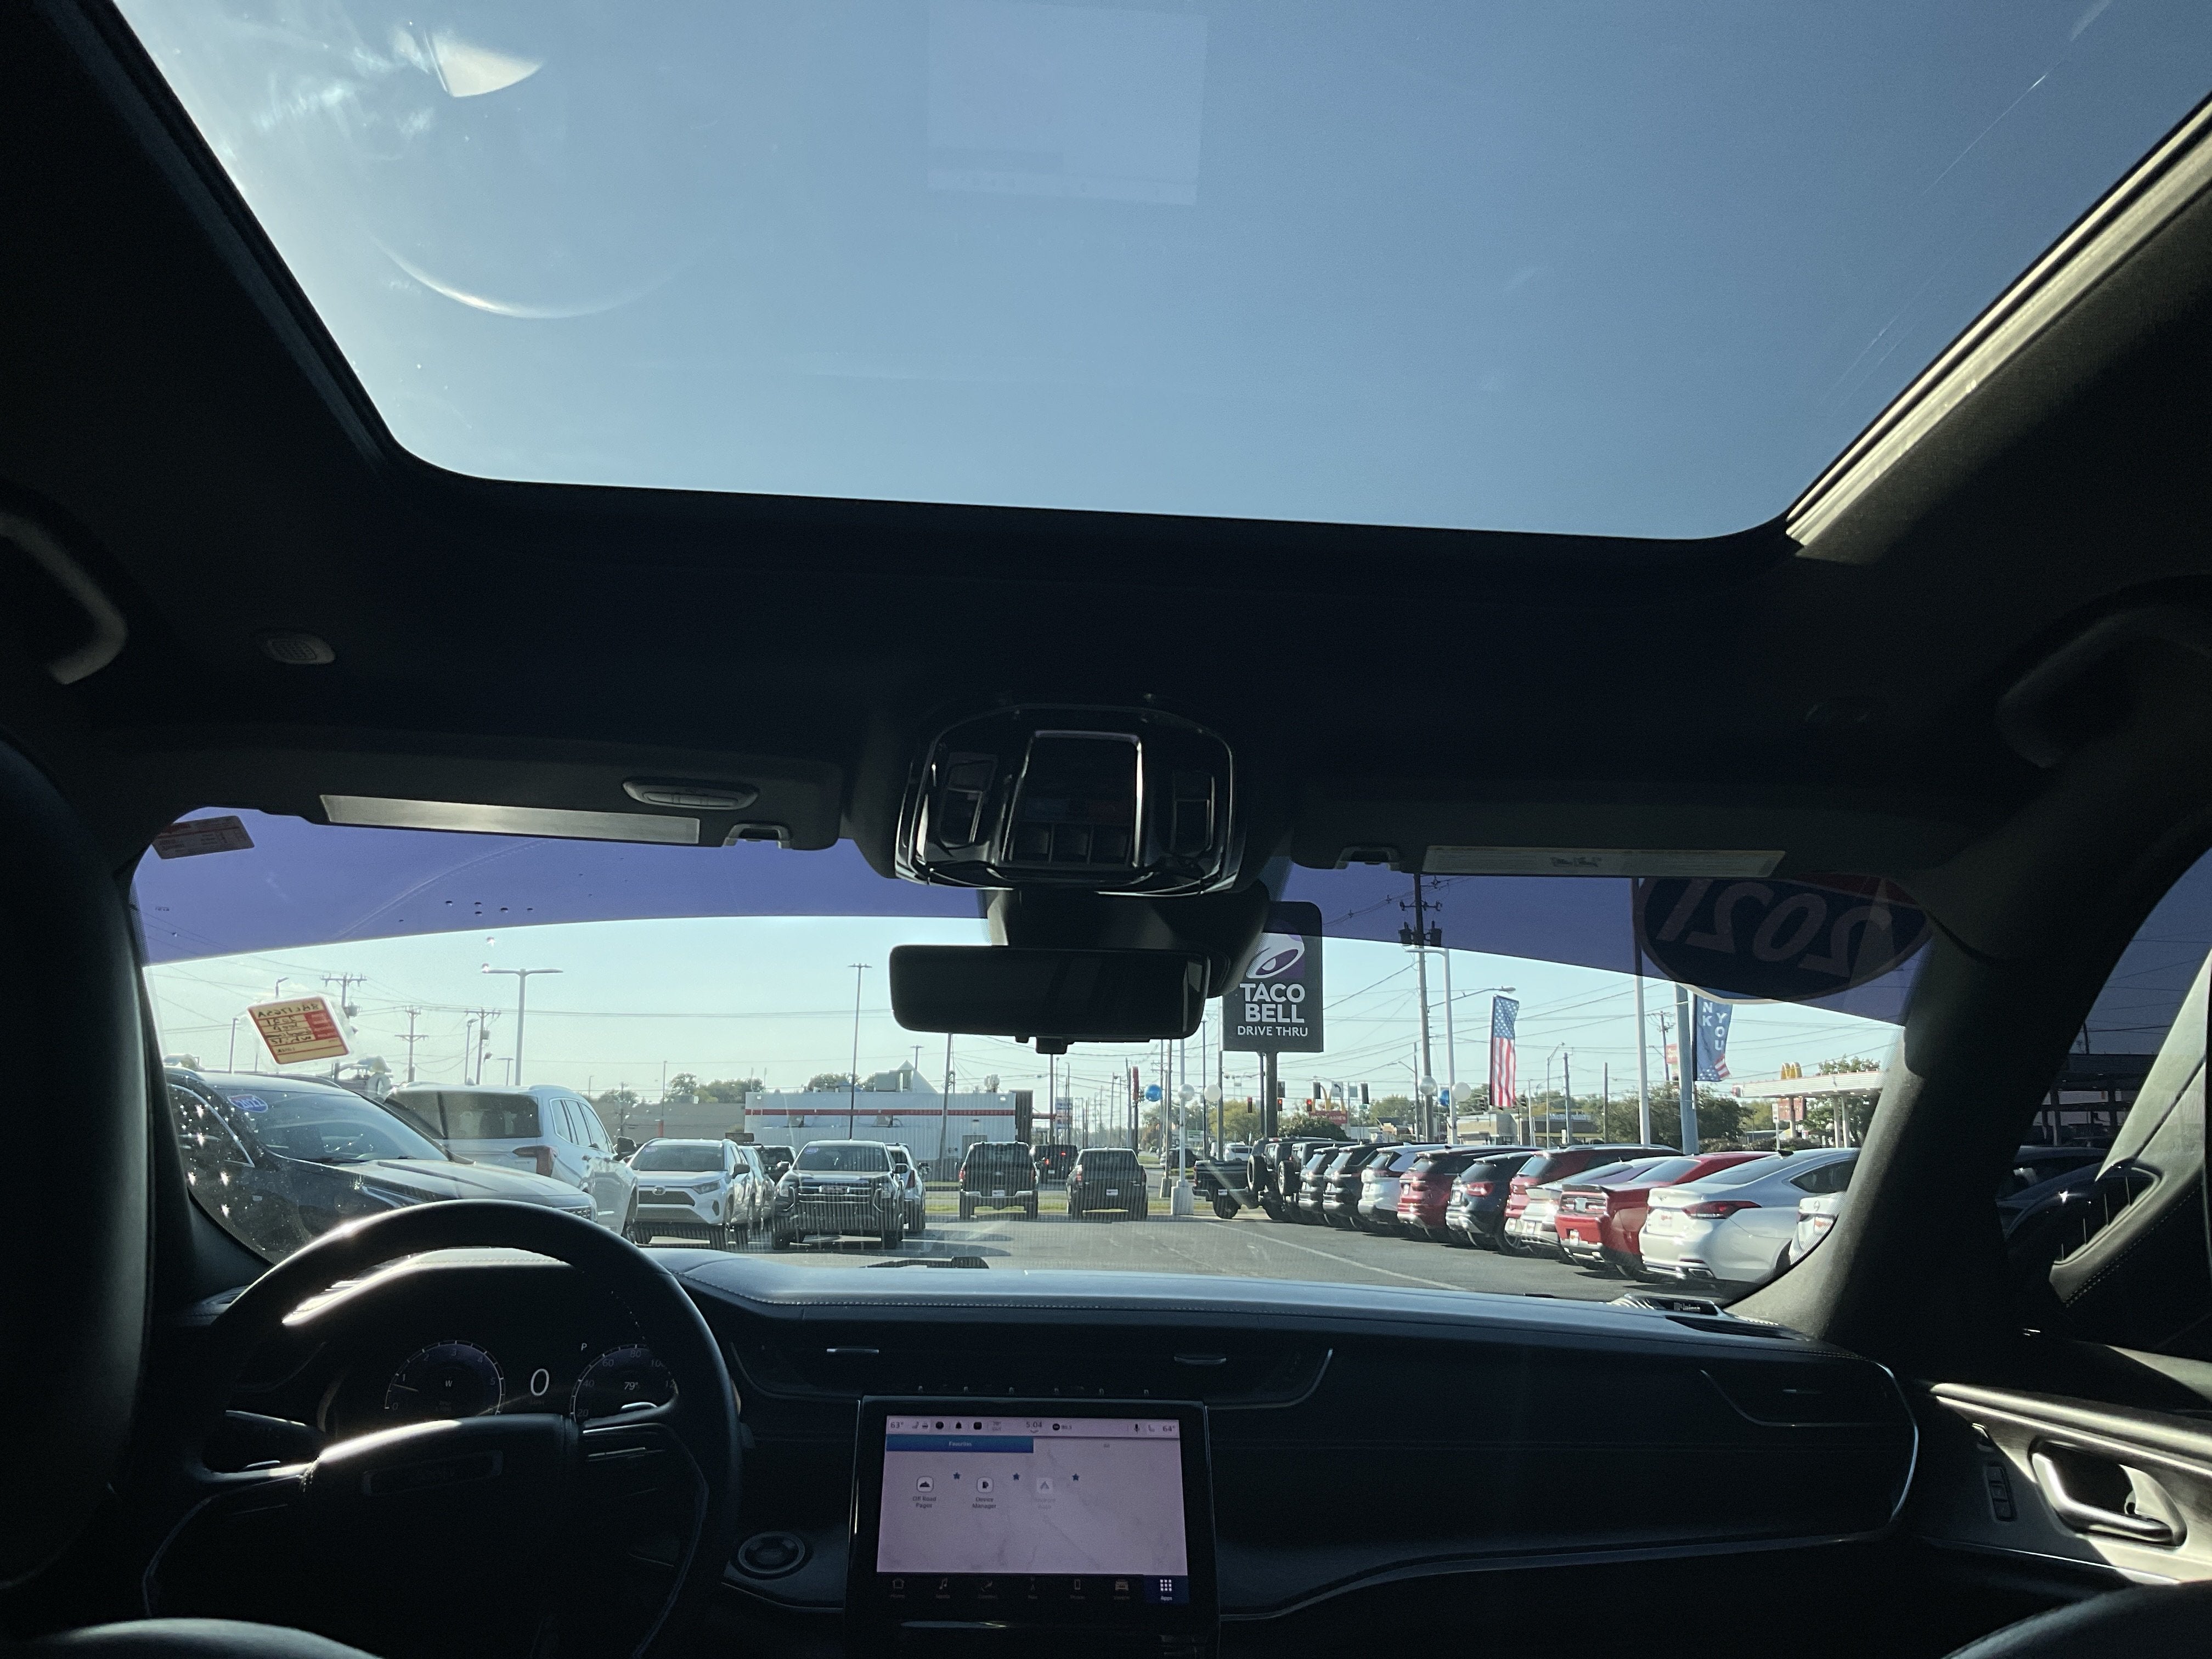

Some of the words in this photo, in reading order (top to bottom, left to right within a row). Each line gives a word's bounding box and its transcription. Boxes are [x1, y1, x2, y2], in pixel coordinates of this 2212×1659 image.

[1239, 983, 1306, 1003] TACO
[1245, 1003, 1305, 1024] BELL
[1237, 1025, 1273, 1036] DRIVE
[1276, 1026, 1308, 1037] THRU
[1714, 1012, 1728, 1051] YOU
[630, 1350, 641, 1358] 80
[602, 1359, 614, 1367] 60
[530, 1368, 550, 1396] 0
[583, 1379, 595, 1387] 40
[577, 1408, 589, 1417] 20
